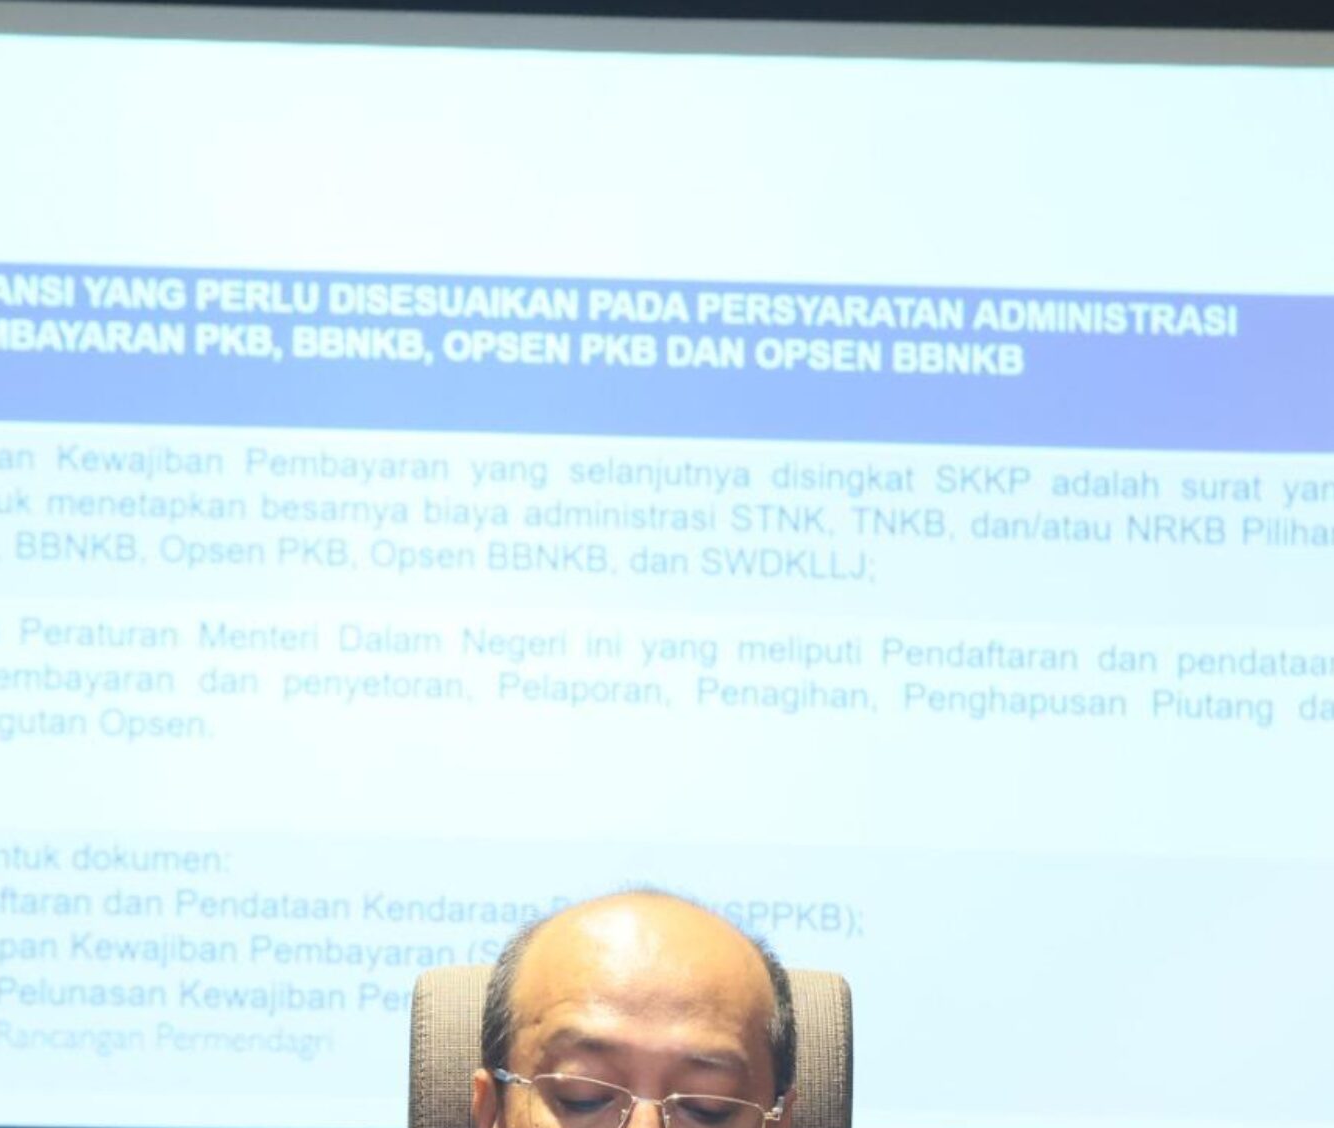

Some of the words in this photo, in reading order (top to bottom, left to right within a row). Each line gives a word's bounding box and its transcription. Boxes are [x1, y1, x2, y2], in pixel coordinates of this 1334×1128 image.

[83, 276, 187, 311] YANG
[195, 279, 319, 314] PERLU
[329, 283, 579, 320] DISESUAIKAN
[589, 289, 689, 323] PADA
[697, 292, 964, 329] PERSYARATAN
[973, 298, 1237, 337] ADMINISTRASI
[443, 329, 570, 364] OPSEN
[580, 333, 657, 366] PKB
[667, 335, 745, 368] DAN
[755, 338, 881, 372] OPSEN
[892, 342, 1024, 375] BBNKB
[57, 445, 224, 480] Kewajiban
[245, 447, 450, 483] Pembayaran
[470, 460, 549, 491] yang
[568, 458, 752, 494] selanjutnya
[770, 462, 915, 500] disingkat
[935, 463, 1032, 497] SKKP
[1051, 469, 1161, 499] adalah
[1180, 475, 1262, 503] surat
[46, 490, 248, 522] menetapkan
[258, 494, 411, 529] besarnya
[422, 497, 512, 531] biaya
[522, 502, 717, 532] administrasi
[969, 511, 1113, 544] dan/atau
[1125, 513, 1227, 545] NRKB
[158, 534, 267, 570] Opsen
[367, 538, 479, 574] Opsen
[628, 546, 689, 575] dan
[20, 617, 180, 649] Peraturan
[198, 620, 318, 653] Menteri
[339, 623, 443, 655] Dalam
[462, 628, 567, 665] Negeri
[586, 634, 623, 658] ini
[641, 637, 719, 670] yang
[737, 636, 862, 669] meliputi
[881, 636, 1078, 671] Pendaftaran
[1098, 645, 1158, 674] dan
[197, 667, 261, 695] dan
[898, 682, 1127, 722] Penghapusan
[1148, 688, 1276, 728] Piutang
[102, 890, 165, 917] dan
[172, 888, 351, 921] Pendataan
[362, 891, 540, 923] Kendaraan
[68, 933, 239, 968] Kewajiban
[248, 934, 457, 972] Pembayaran
[178, 980, 347, 1017] Kewajiban
[156, 1021, 332, 1061] Permendagri
